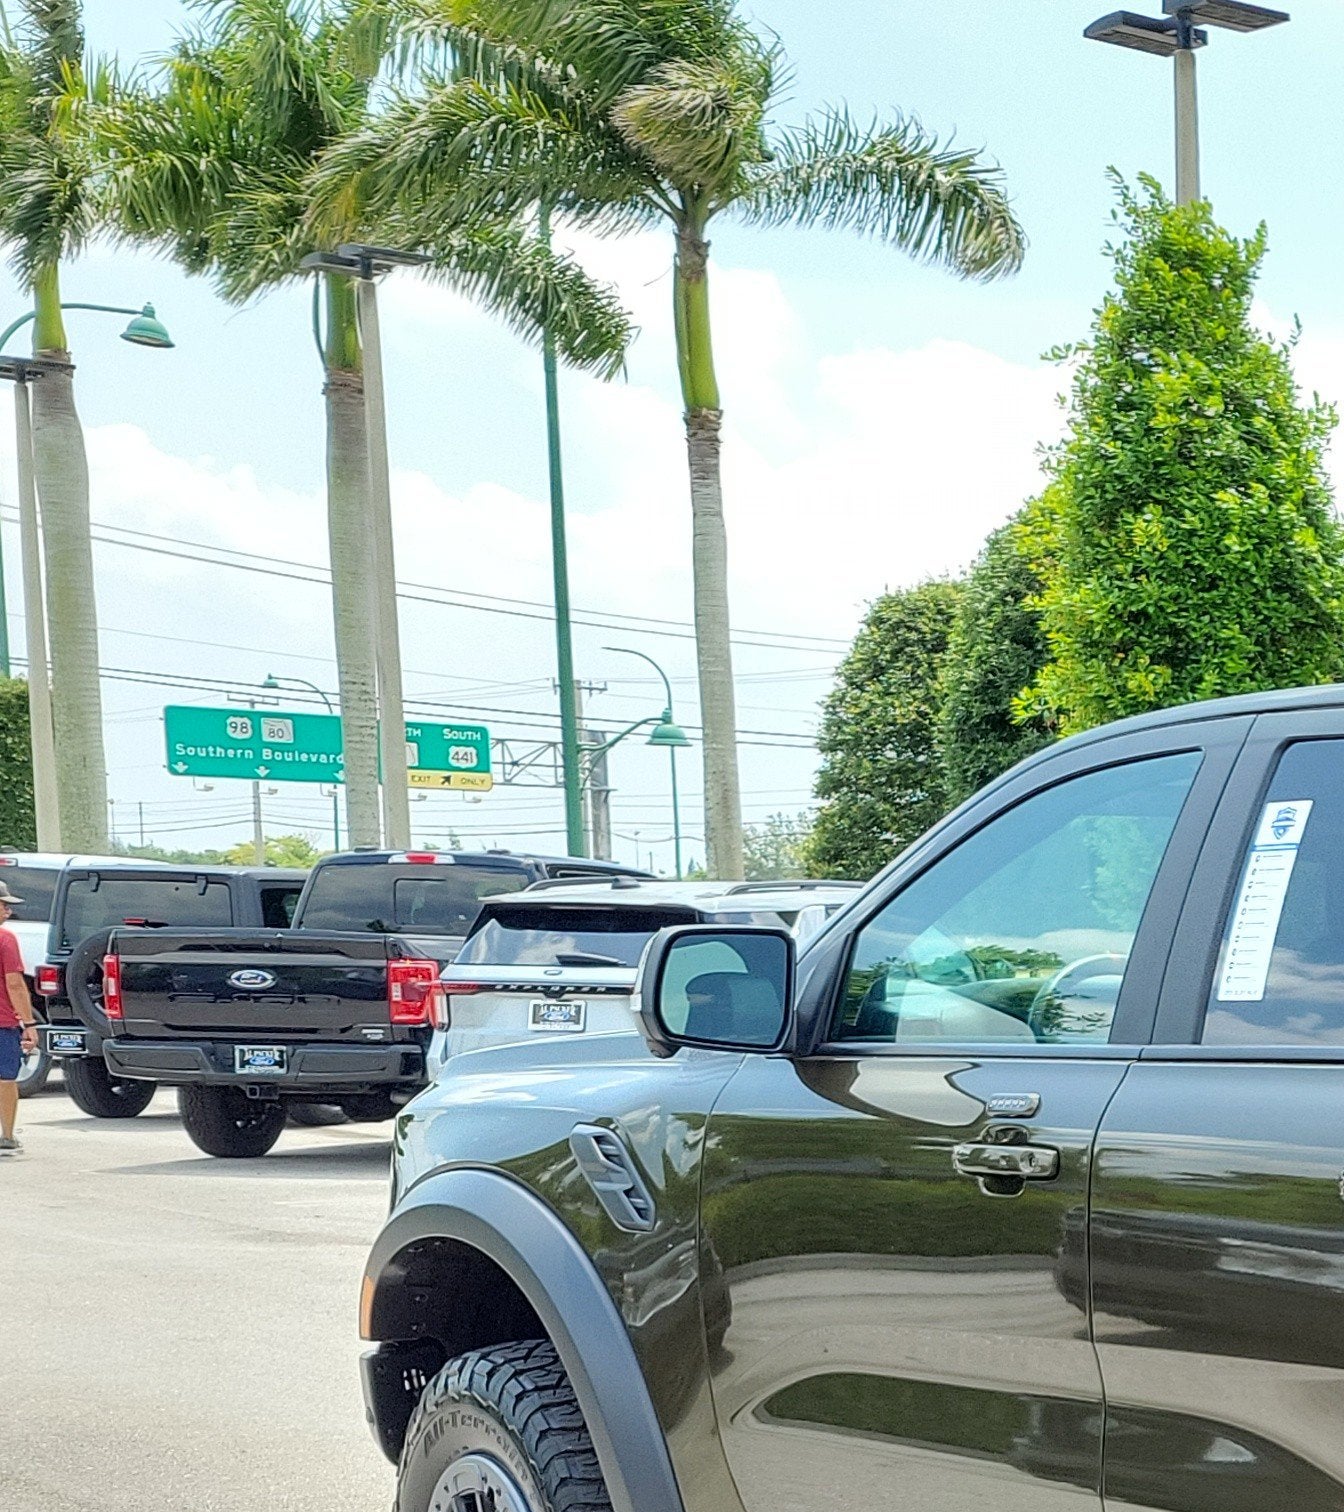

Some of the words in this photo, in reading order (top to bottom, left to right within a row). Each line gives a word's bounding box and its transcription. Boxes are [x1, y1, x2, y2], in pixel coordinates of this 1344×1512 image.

[229, 721, 249, 734] 98
[268, 728, 285, 739] 80
[442, 728, 481, 741] SOUTH
[175, 743, 254, 759] Southern
[451, 750, 474, 764] 441
[411, 775, 431, 783] EXIT
[460, 777, 486, 786] ONLY
